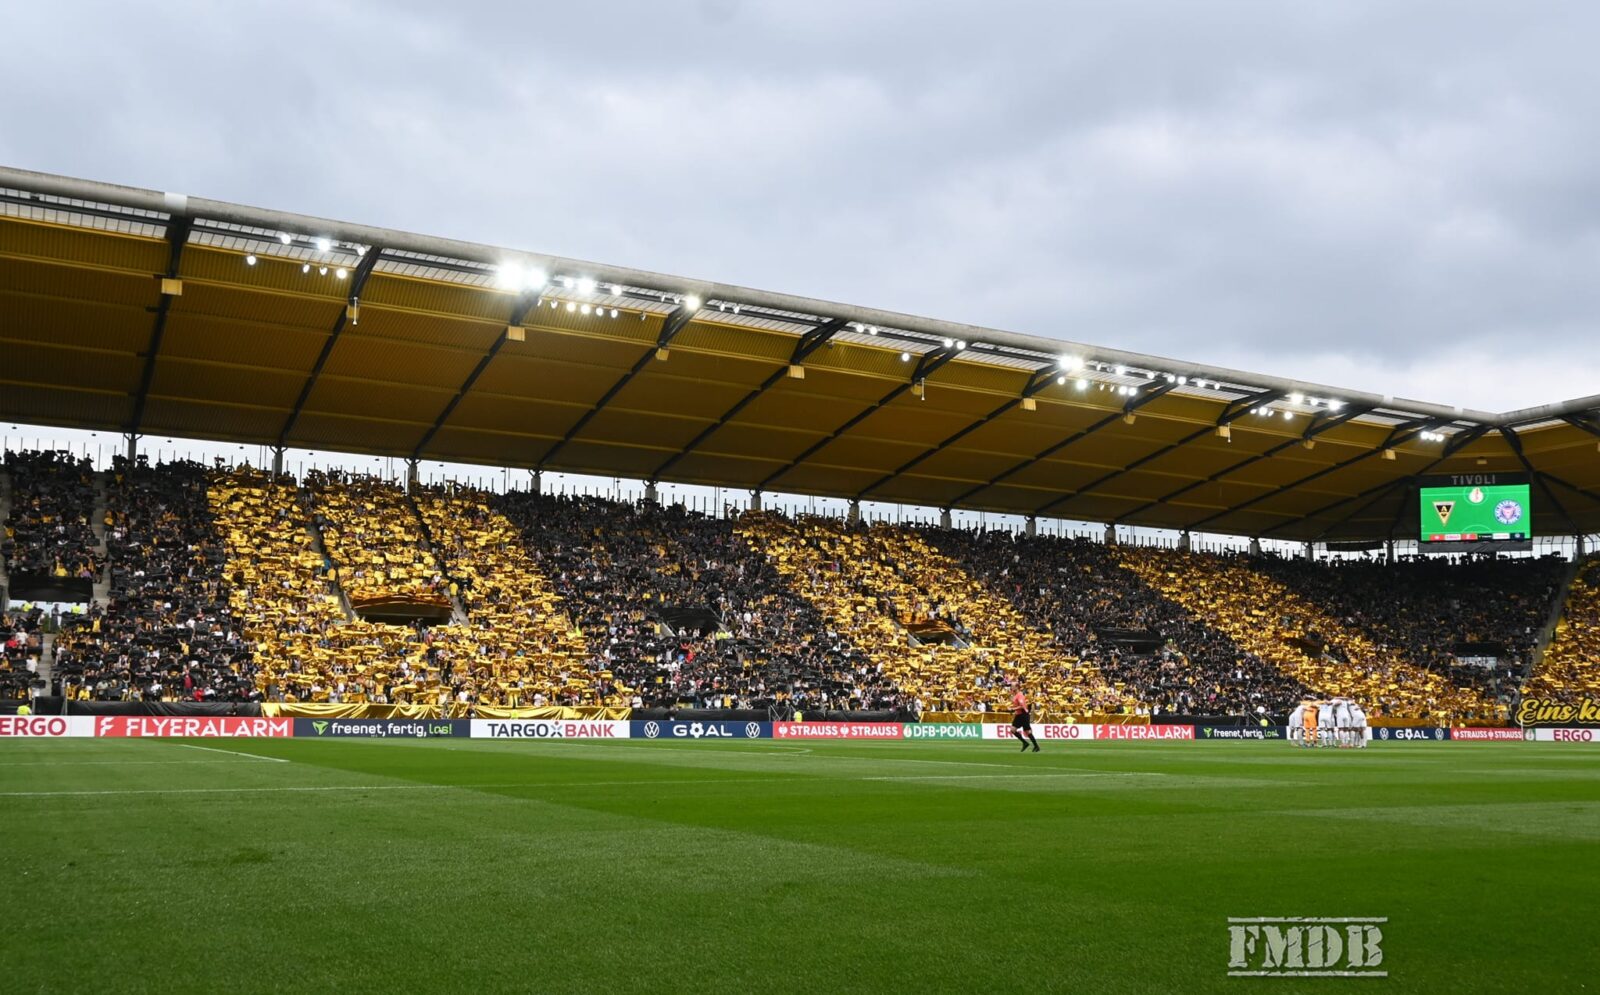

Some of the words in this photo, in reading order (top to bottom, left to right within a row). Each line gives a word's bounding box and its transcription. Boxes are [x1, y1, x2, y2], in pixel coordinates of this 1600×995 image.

[1451, 475, 1496, 485] TIVOLI
[1518, 699, 1577, 723] Eins
[0, 717, 66, 736] ERGO
[126, 717, 289, 737] FLYERALARM
[790, 725, 838, 736] STRAUSS
[851, 725, 899, 736] STRAUSS
[913, 725, 979, 738] DFB-POKAL
[1045, 725, 1079, 738] ERGO
[1109, 726, 1193, 739] FLYERALARM
[1460, 730, 1488, 739] STRAUSS
[1494, 730, 1522, 739] STRAUSS
[1553, 730, 1593, 741] ERGO
